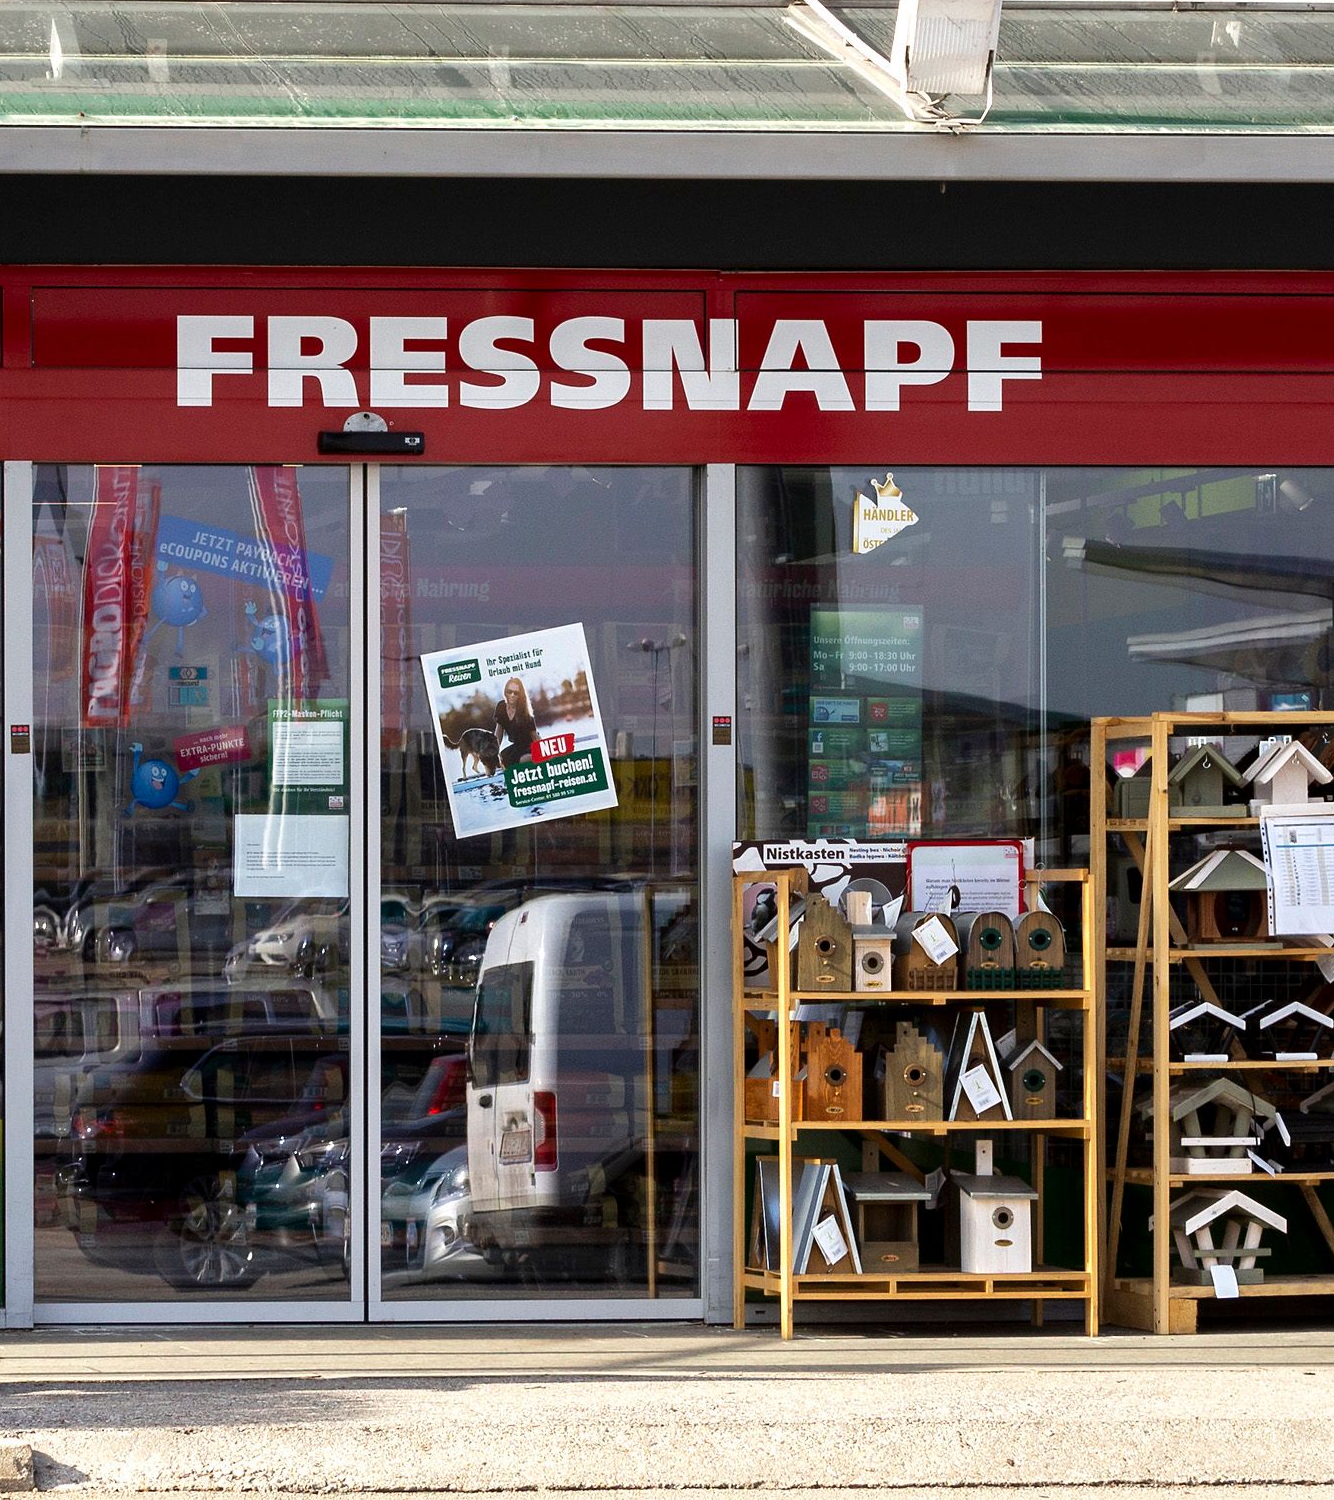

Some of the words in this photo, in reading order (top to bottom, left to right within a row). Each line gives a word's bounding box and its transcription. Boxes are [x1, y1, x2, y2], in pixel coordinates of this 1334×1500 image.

[176, 314, 1044, 412] FRESSNAPF
[863, 506, 914, 522] HÄNDLER
[159, 542, 229, 569] eCOUPONS
[192, 531, 234, 551] JETZT
[236, 542, 296, 568] PAYBACK
[813, 636, 842, 645] Unsere
[844, 635, 910, 647] Öffnungszeiten:
[485, 658, 496, 667] Ihr
[498, 650, 531, 666] Spezialist
[900, 652, 916, 660] Uhr
[440, 663, 475, 675] FRESSNAPF
[488, 665, 511, 677] Urlaub
[512, 663, 524, 673] mit
[525, 659, 542, 670] Hund
[813, 663, 824, 671] Sa
[900, 664, 916, 672] Uhr
[448, 672, 472, 683] Reisen
[180, 738, 245, 757] EXTRA-PUNKTE
[538, 737, 567, 758] NEU
[511, 765, 544, 785] Jetzt
[546, 753, 594, 778] buchen!
[513, 771, 598, 798] fressnapf-reisen.at
[766, 847, 845, 861] Nistkasten
